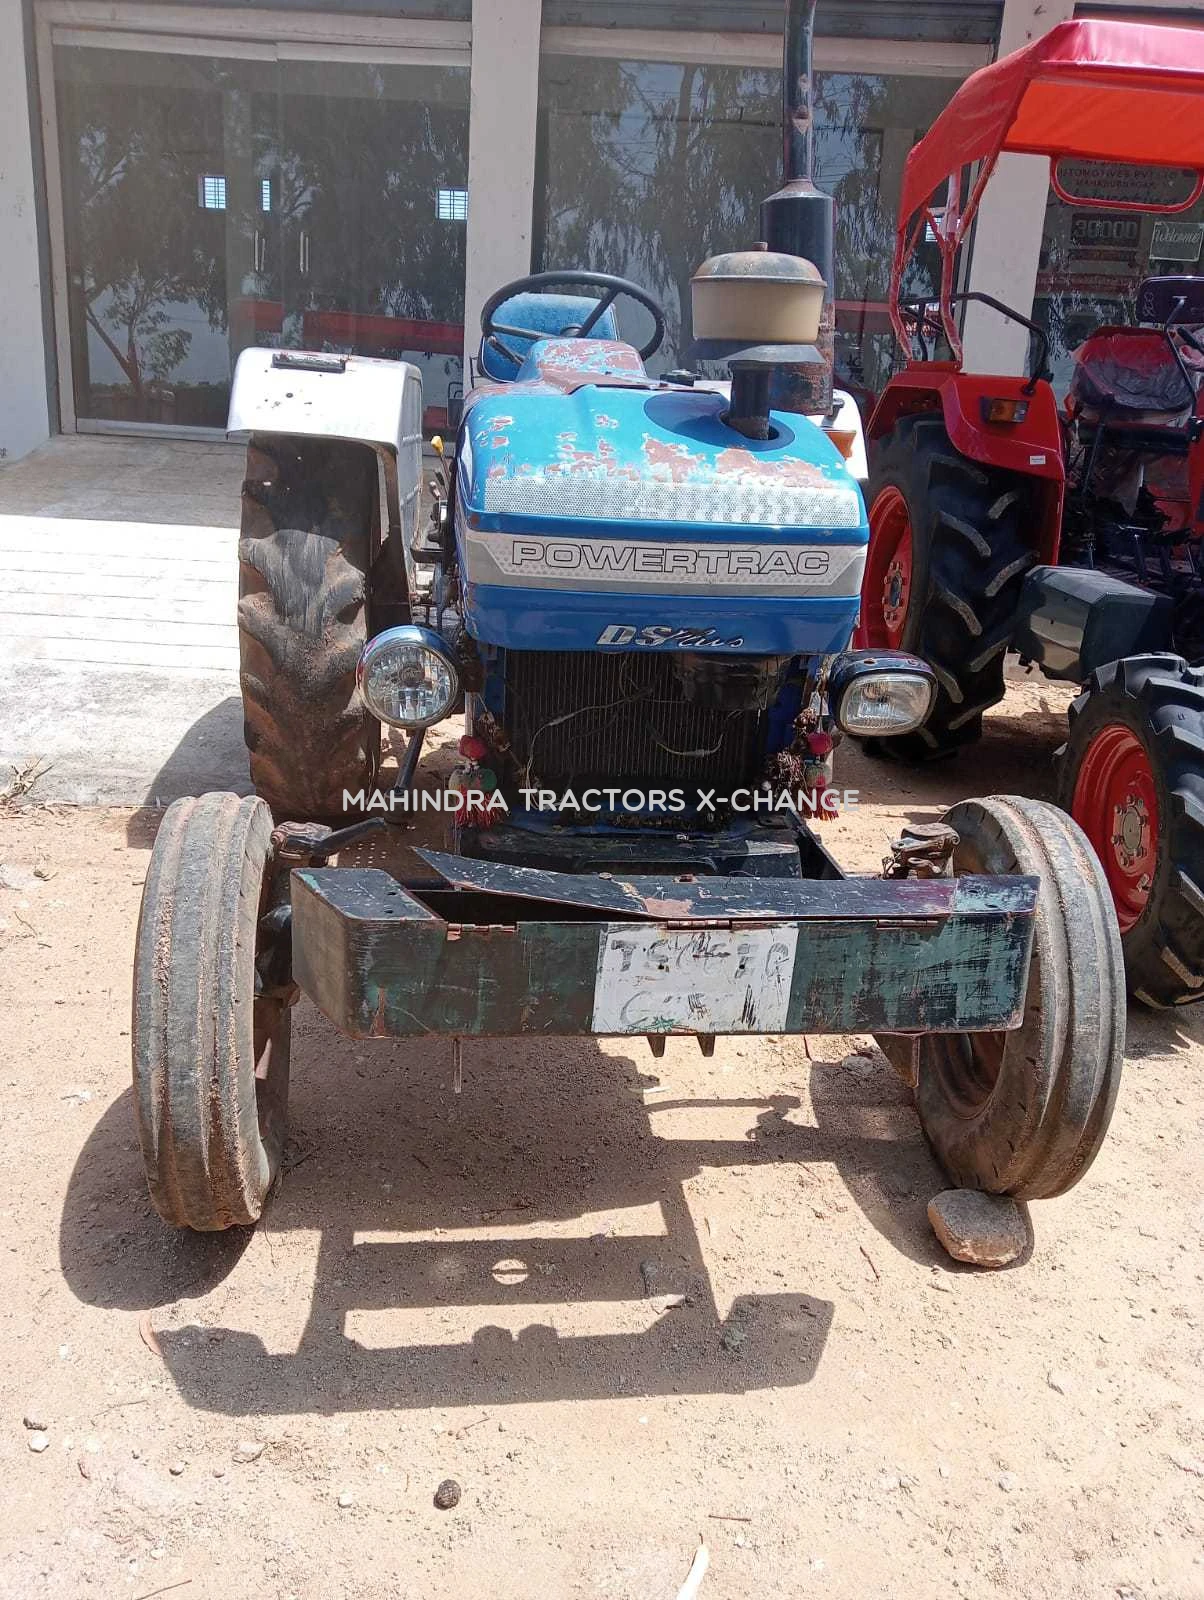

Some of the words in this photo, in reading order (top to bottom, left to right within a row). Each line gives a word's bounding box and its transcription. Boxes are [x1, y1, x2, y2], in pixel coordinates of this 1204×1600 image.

[1059, 167, 1129, 178] UTOMOTIVES
[1155, 223, 1200, 243] Welcome
[512, 540, 829, 575] POWERTRAC
